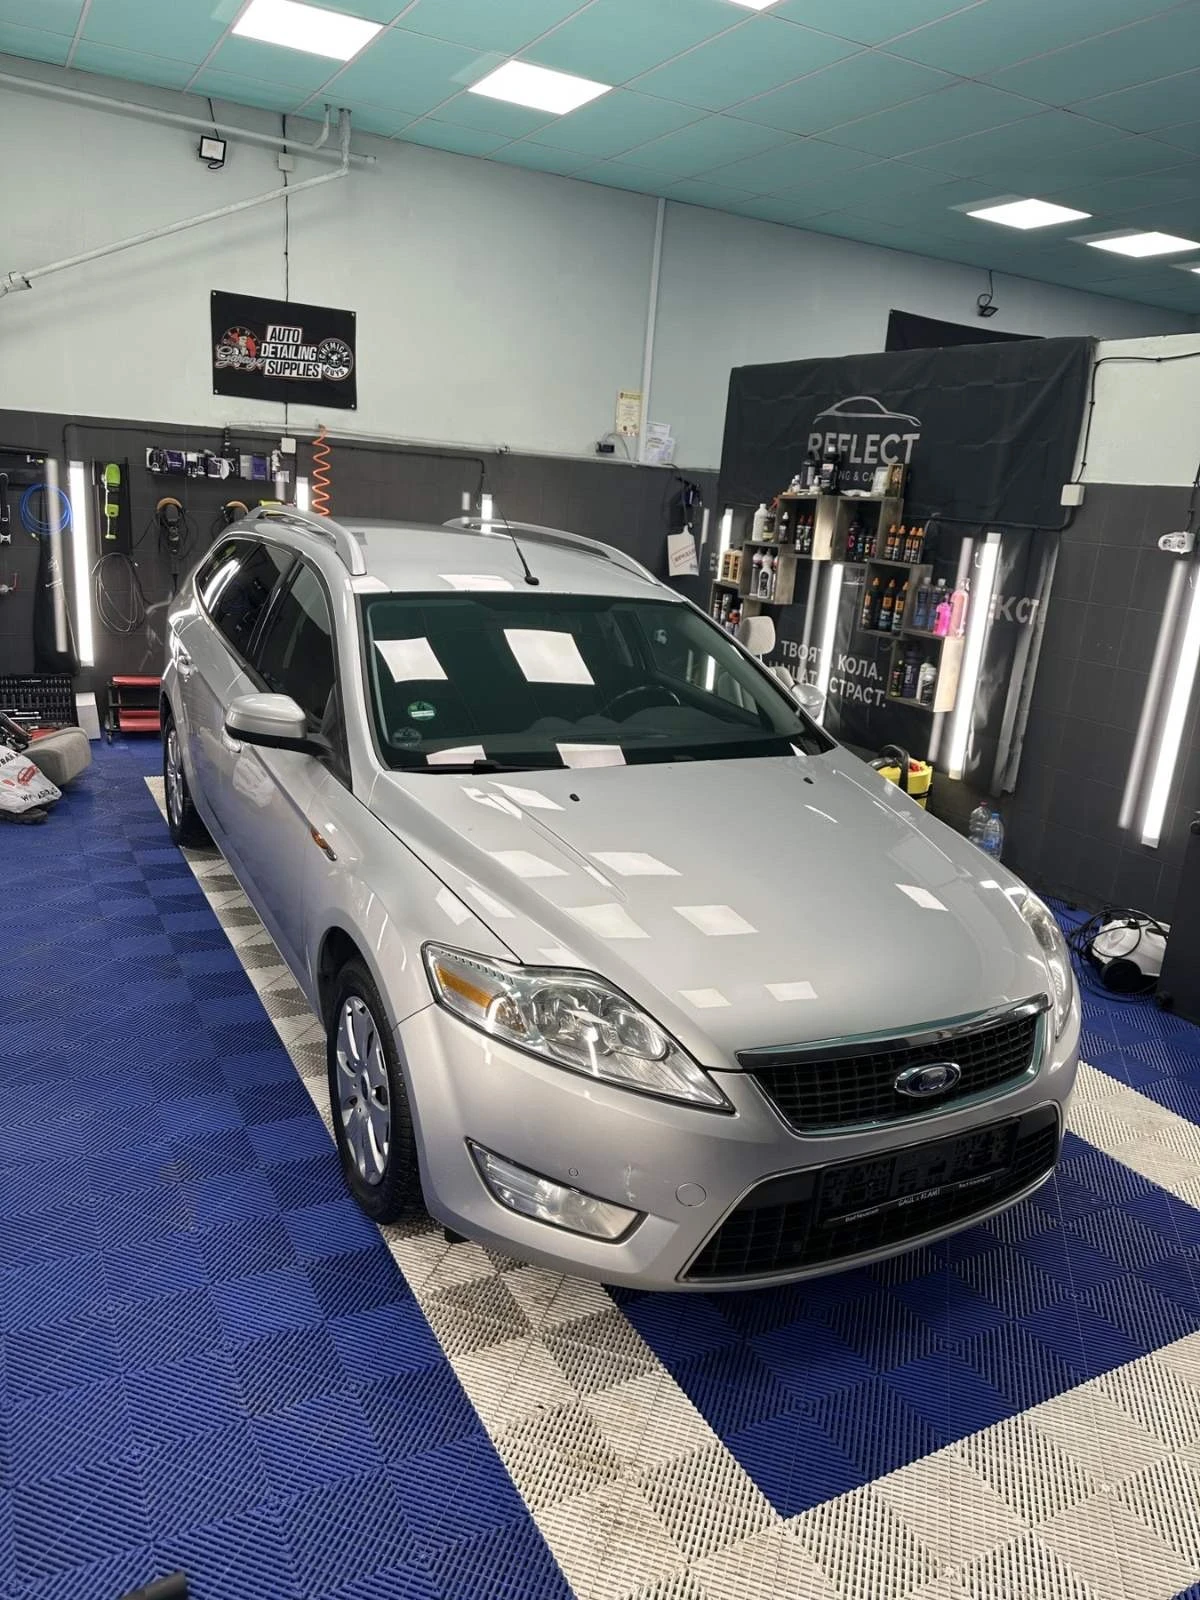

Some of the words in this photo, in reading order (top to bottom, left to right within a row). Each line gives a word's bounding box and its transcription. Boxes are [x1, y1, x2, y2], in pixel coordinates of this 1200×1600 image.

[269, 327, 300, 343] AUTO
[261, 342, 318, 361] DETAILING
[267, 360, 320, 378] SUPPLIES
[324, 366, 346, 377] GUYS
[807, 432, 921, 465] REFLECT
[838, 653, 884, 682] КОЛА.
[829, 676, 887, 708] СТРАСТ.
